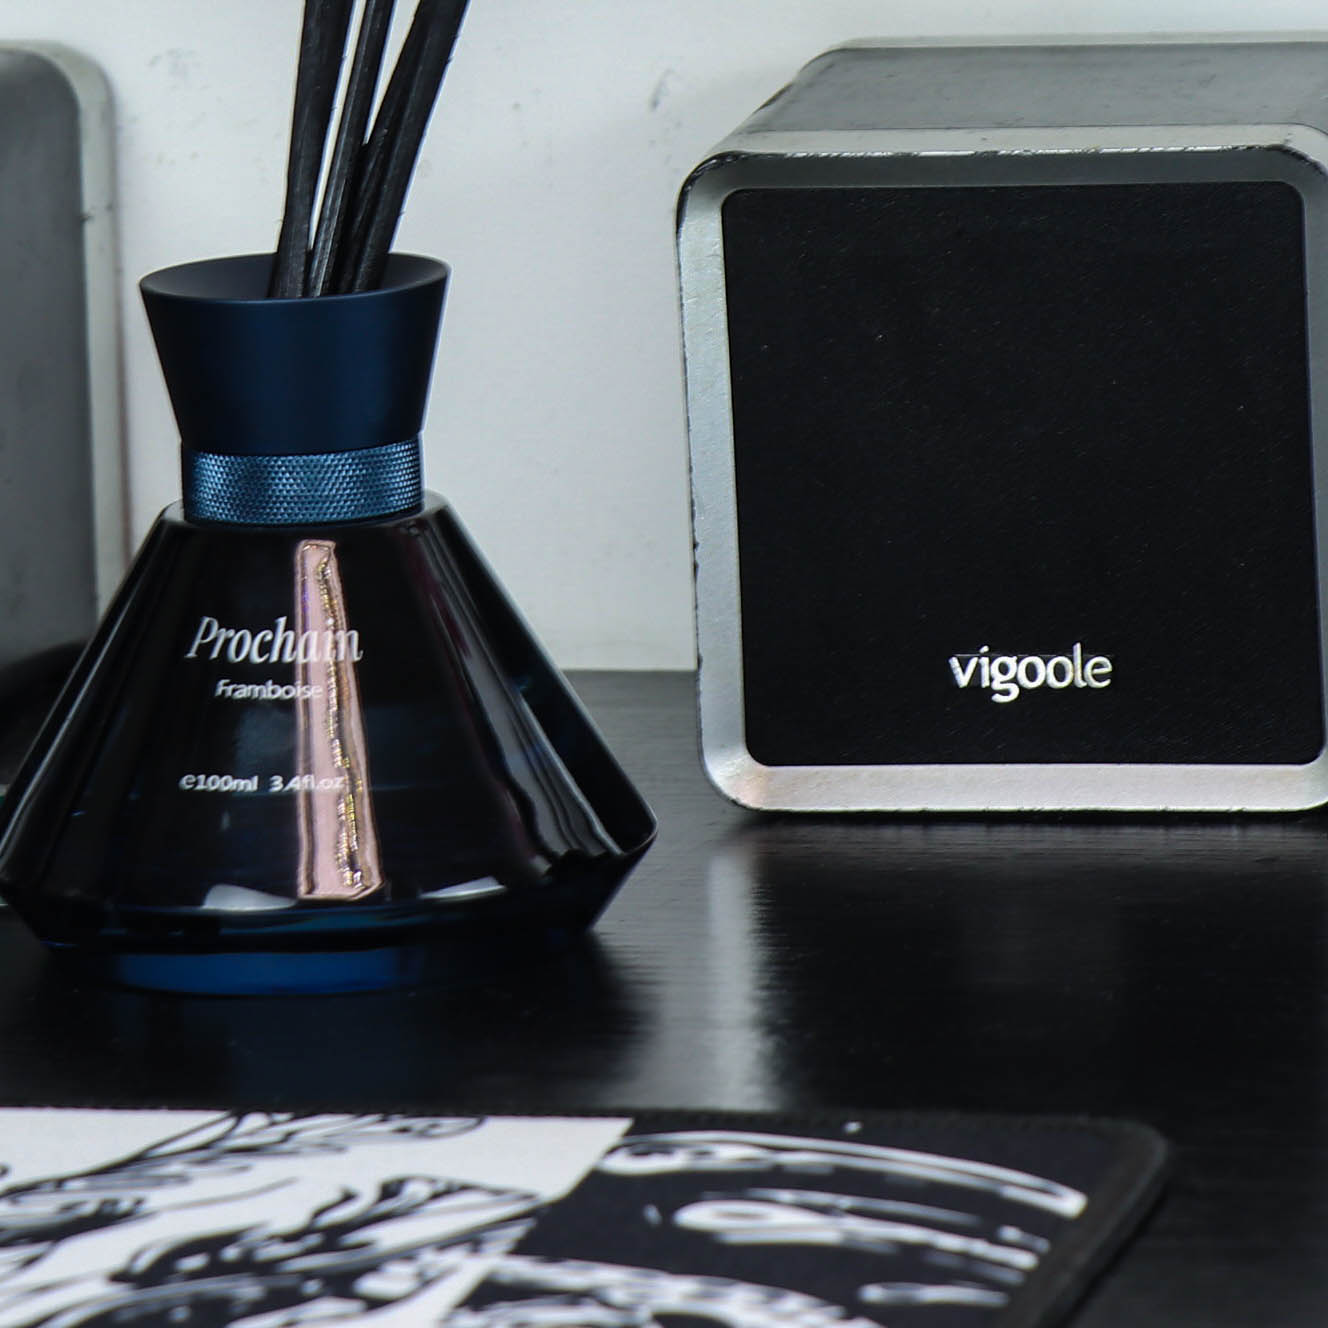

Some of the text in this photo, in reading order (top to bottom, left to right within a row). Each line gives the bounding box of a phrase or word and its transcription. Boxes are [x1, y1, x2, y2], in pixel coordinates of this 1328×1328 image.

[184, 616, 364, 664] Prochain
[215, 679, 322, 700] Framboise
[948, 642, 1113, 703] vigoole
